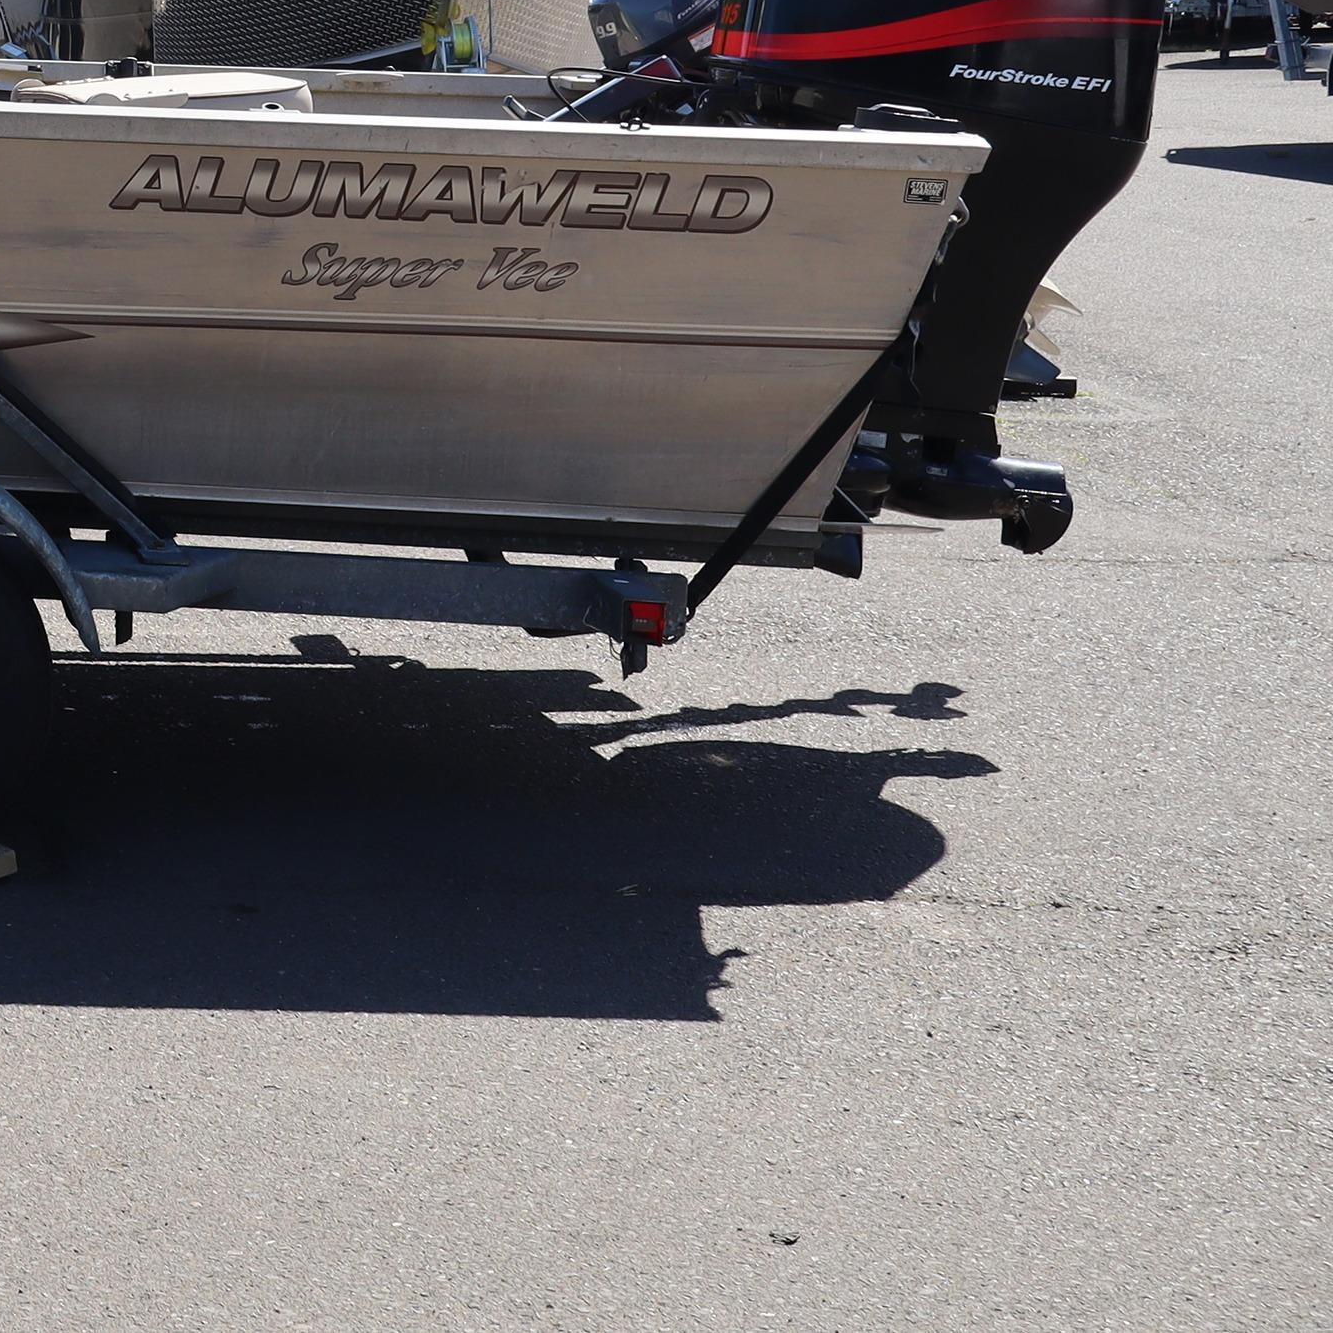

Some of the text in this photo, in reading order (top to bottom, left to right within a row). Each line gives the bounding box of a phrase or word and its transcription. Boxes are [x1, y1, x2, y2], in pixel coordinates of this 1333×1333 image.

[949, 64, 1111, 93] FourStroke EFI
[109, 154, 774, 234] ALUMAWELD
[281, 242, 579, 300] Super Vee
